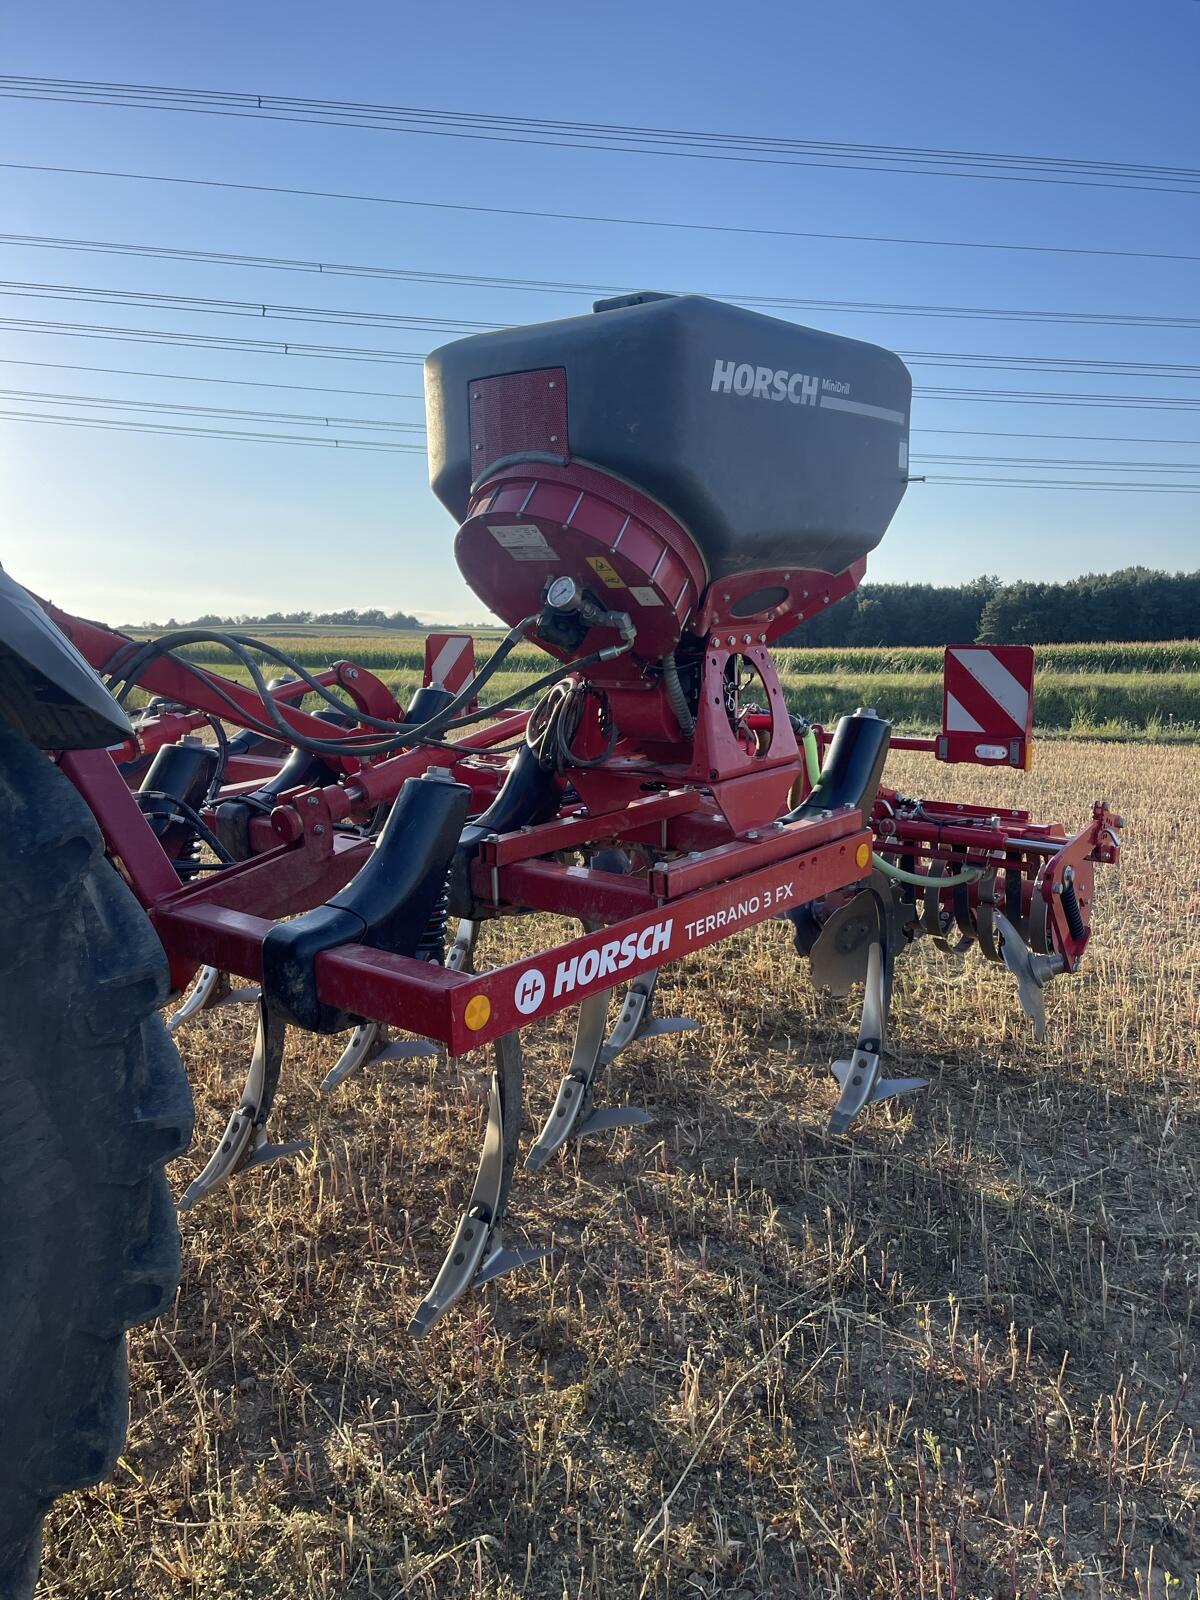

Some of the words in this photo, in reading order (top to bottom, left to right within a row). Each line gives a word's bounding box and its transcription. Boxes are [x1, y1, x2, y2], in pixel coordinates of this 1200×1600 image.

[711, 359, 818, 406] HORSCH
[821, 378, 850, 395] MiniDrill
[553, 919, 673, 997] HORSCH
[685, 896, 759, 939] TERRANO
[763, 890, 772, 909] 3
[775, 882, 793, 900] FX
